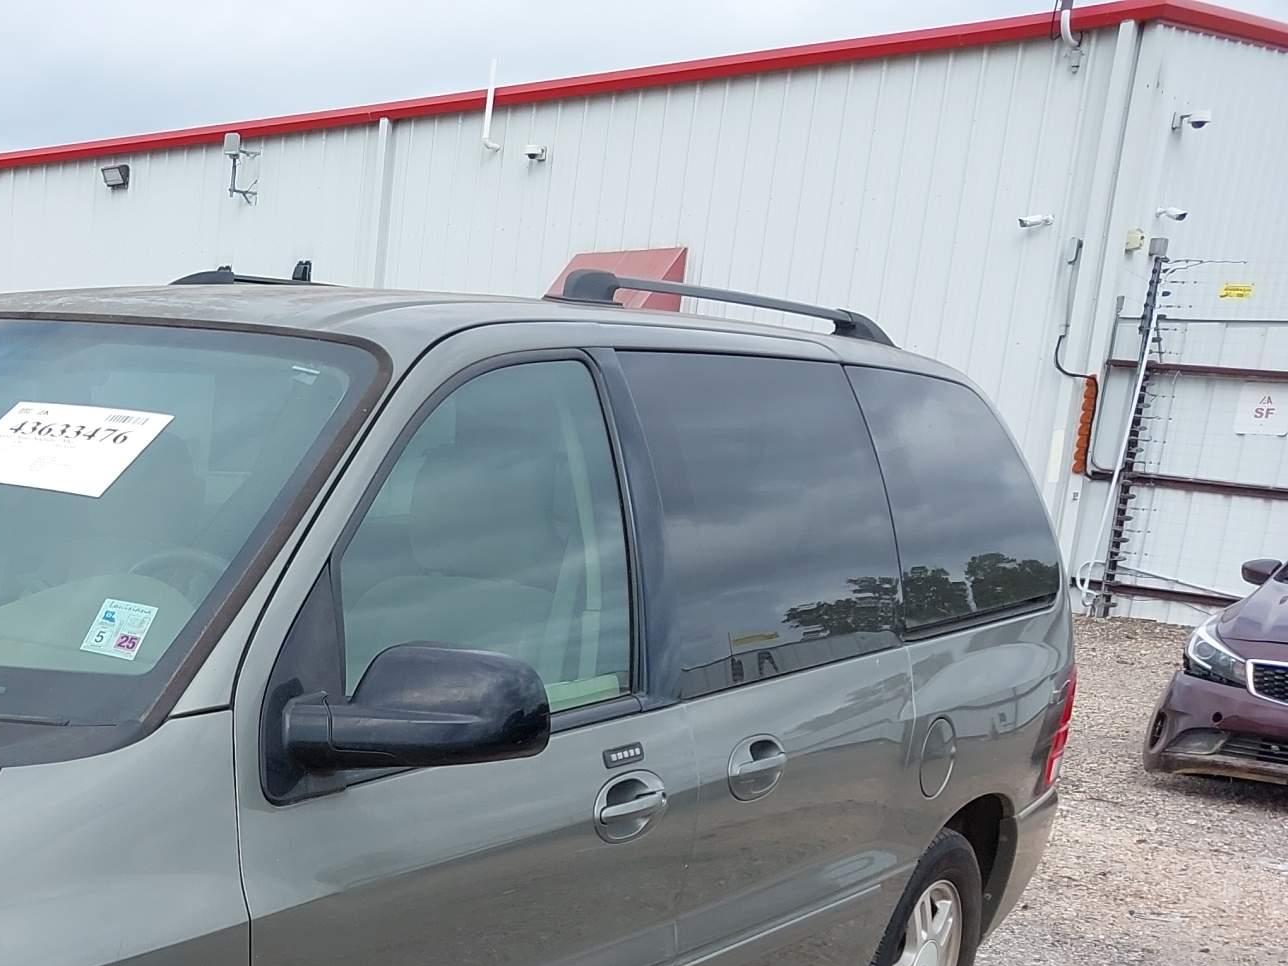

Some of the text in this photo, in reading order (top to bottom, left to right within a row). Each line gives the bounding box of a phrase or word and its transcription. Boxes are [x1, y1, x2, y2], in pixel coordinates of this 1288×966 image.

[1254, 407, 1276, 419] SF
[9, 420, 134, 445] 43633476
[94, 631, 106, 643] 5
[117, 635, 138, 650] 25
